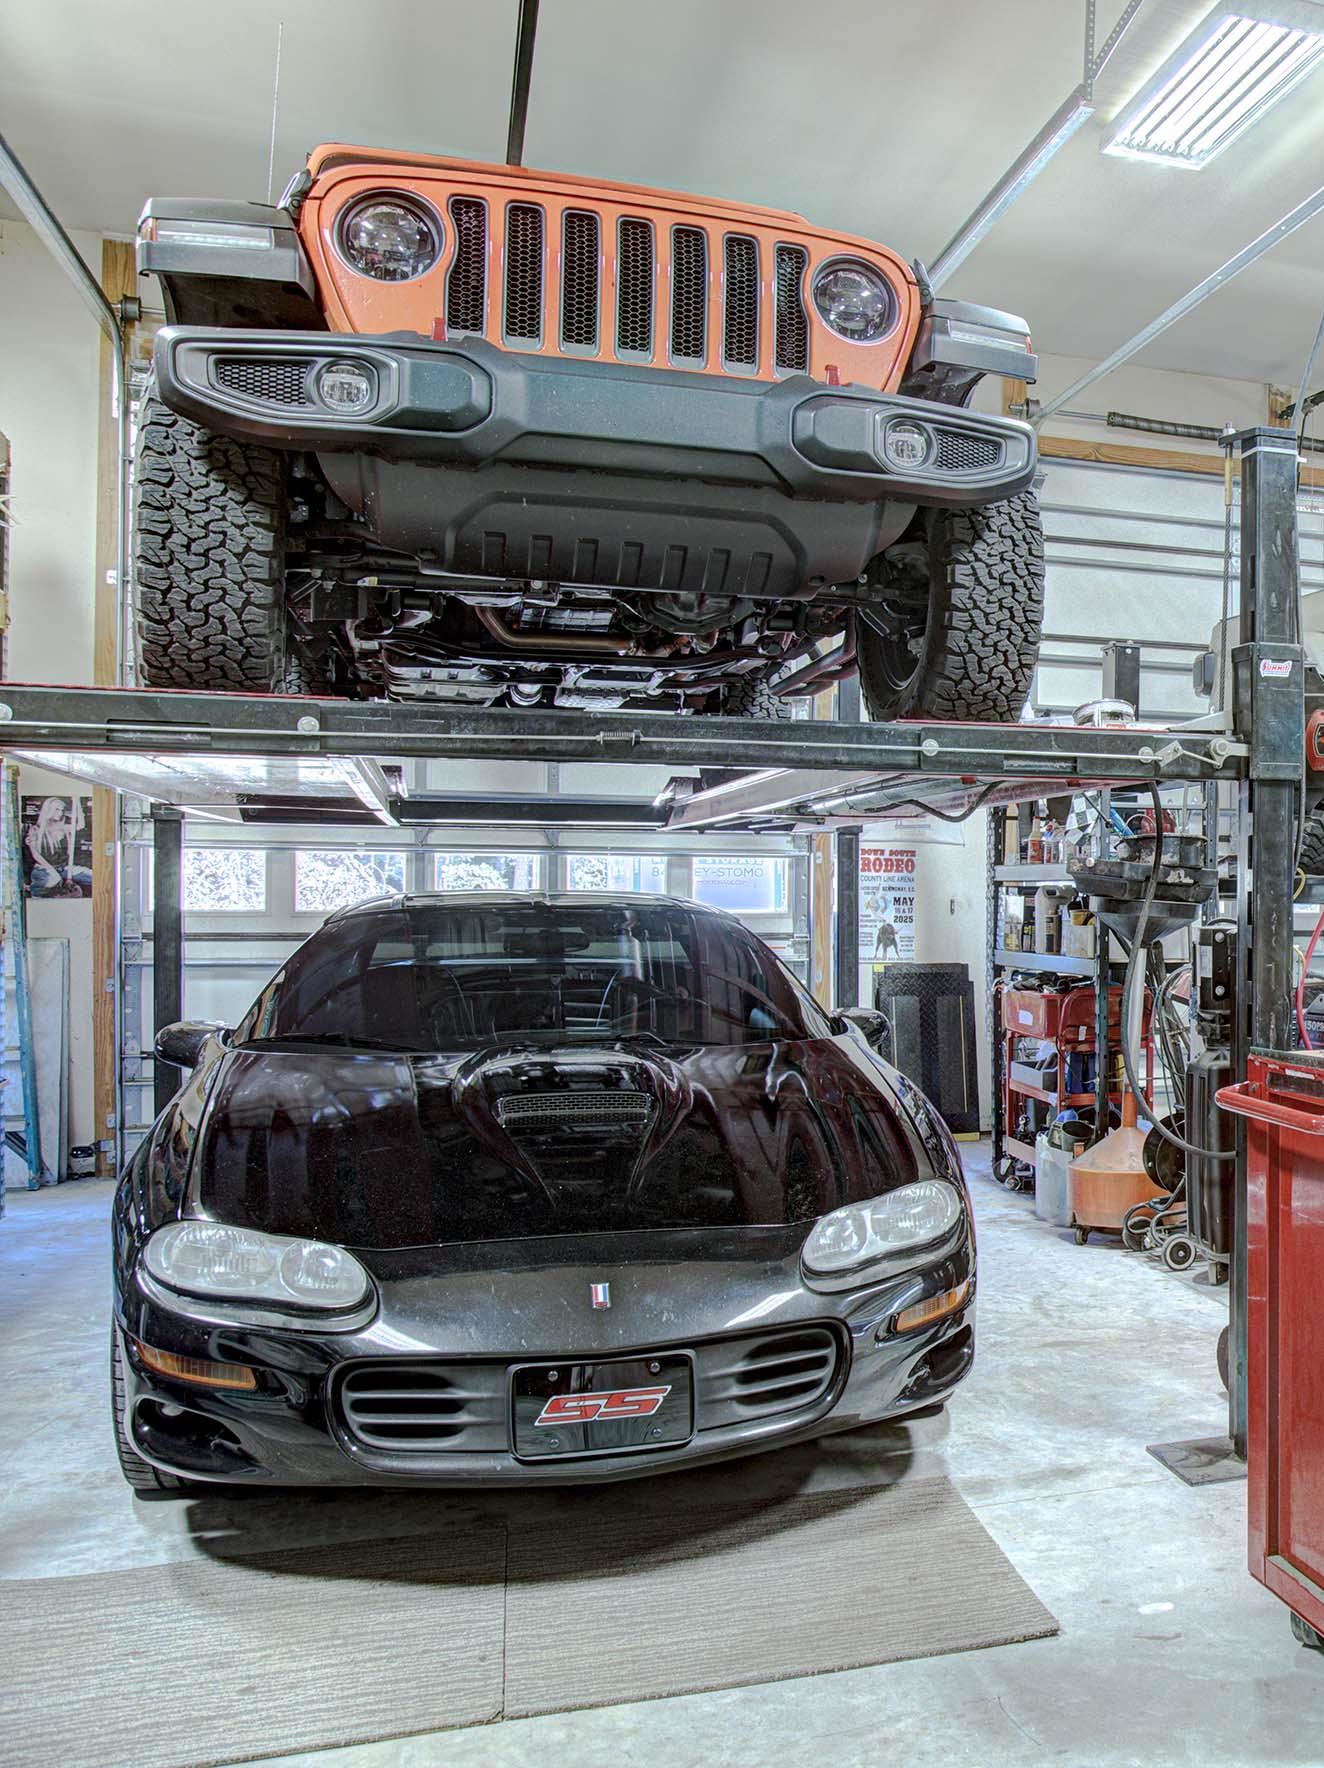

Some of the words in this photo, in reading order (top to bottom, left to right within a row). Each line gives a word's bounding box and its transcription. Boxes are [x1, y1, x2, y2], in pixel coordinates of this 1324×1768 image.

[860, 857, 916, 874] RODEO
[893, 896, 914, 906] MAY
[893, 915, 914, 923] 2025
[534, 1385, 672, 1426] SS
